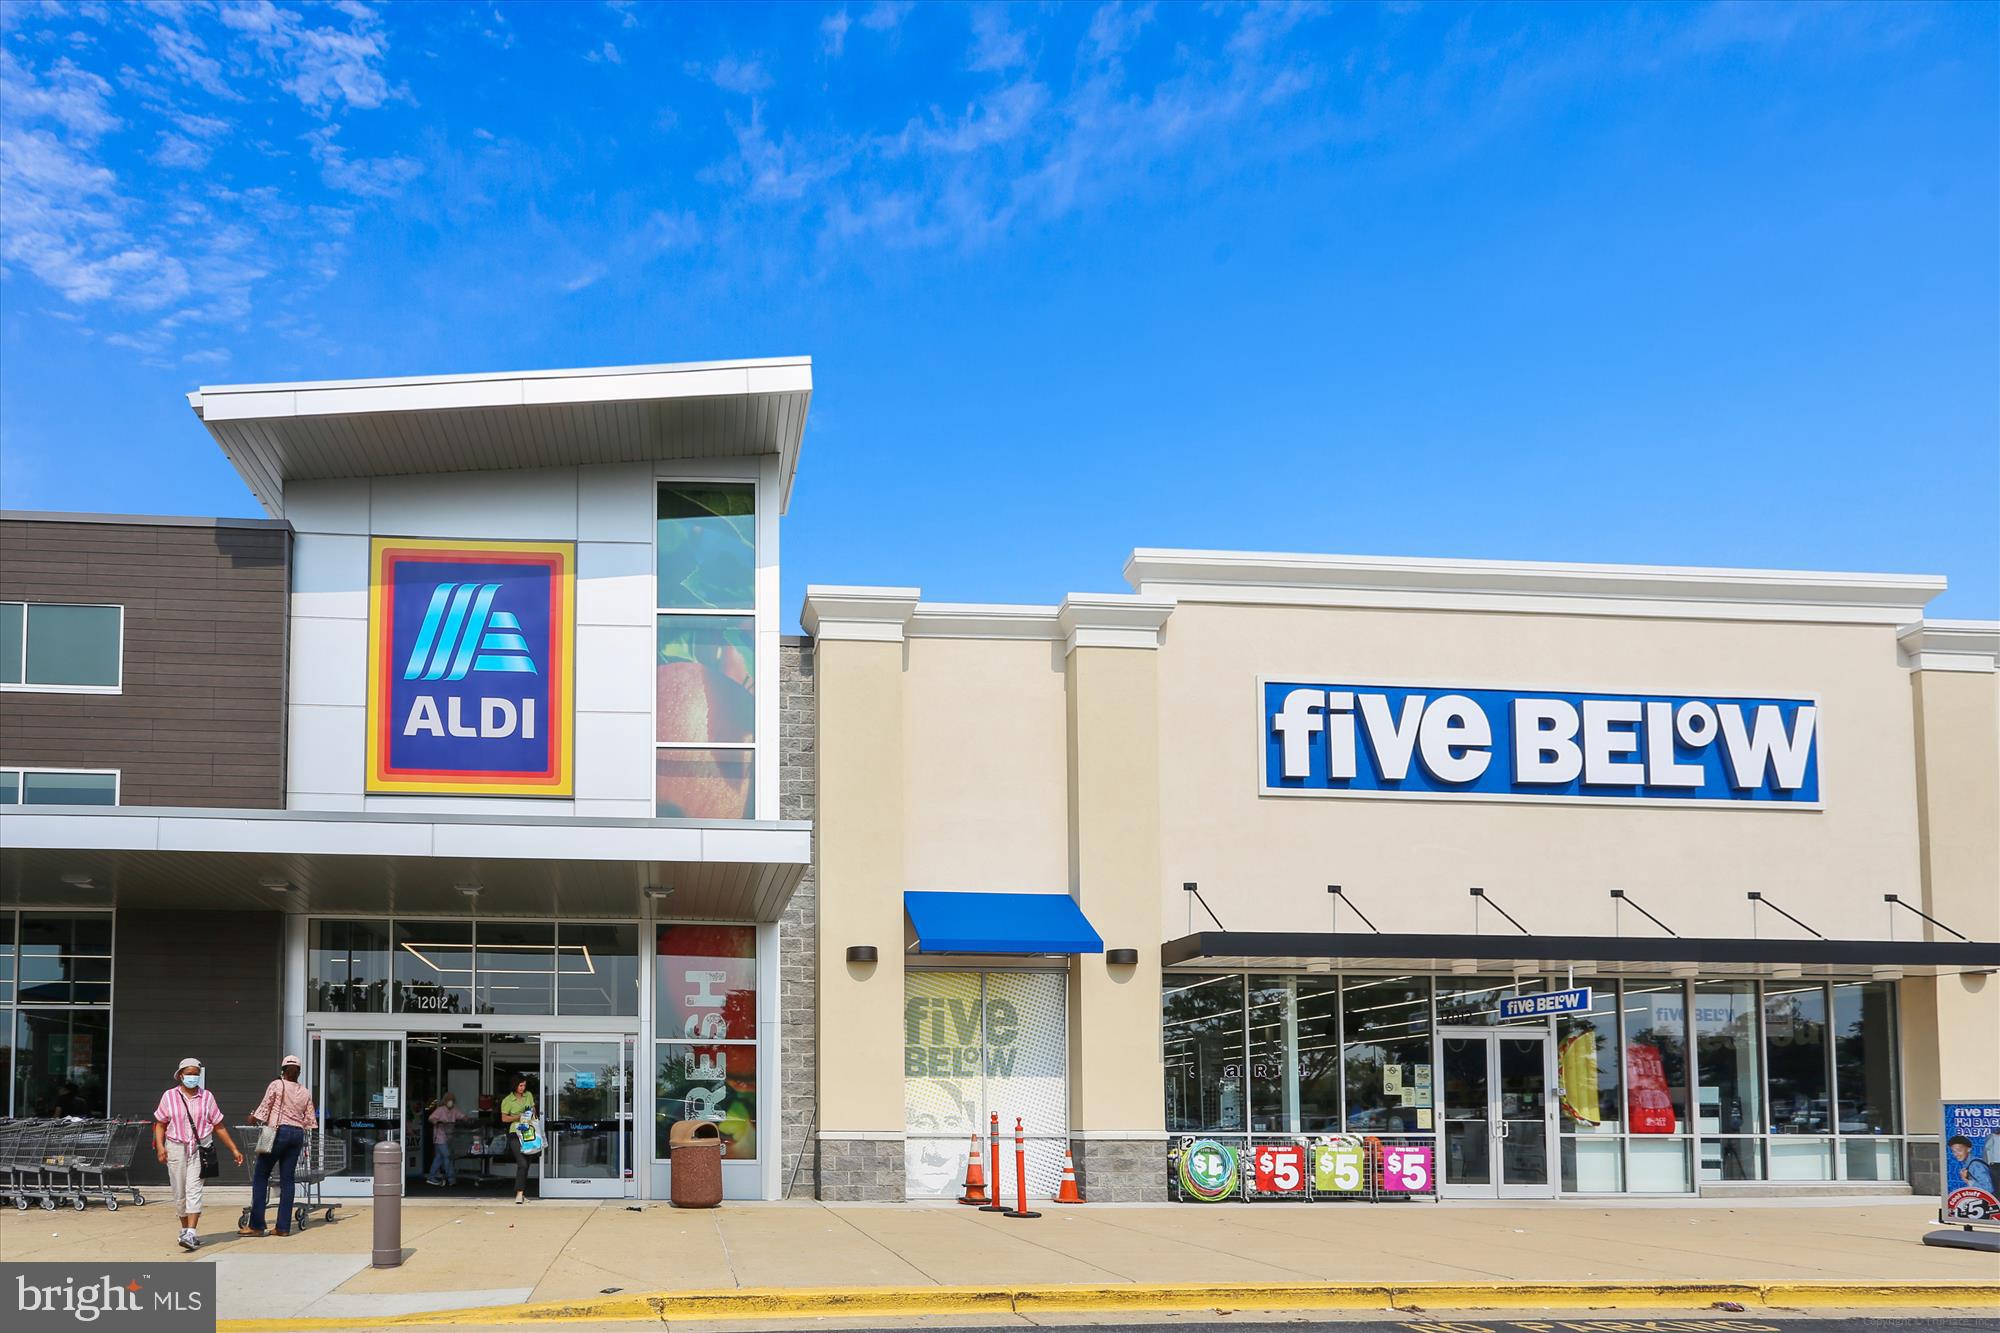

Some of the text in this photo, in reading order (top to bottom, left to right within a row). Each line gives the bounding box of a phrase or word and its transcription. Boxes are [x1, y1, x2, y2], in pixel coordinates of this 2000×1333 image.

[403, 695, 536, 739] ALDI
[1272, 689, 1817, 790] five BELOW
[417, 995, 448, 1010] 12012
[1507, 992, 1580, 1015] five BELOW
[906, 996, 1019, 1047] five
[685, 969, 727, 1155] RESH
[904, 1046, 1017, 1079] BELOW
[570, 1122, 594, 1130] Welcome
[1954, 1108, 2000, 1117] five BE
[1972, 1117, 2000, 1128] BAC
[1183, 1137, 1193, 1148] $2
[1259, 1152, 1300, 1190] $5
[1319, 1152, 1360, 1190] $5
[1387, 1152, 1427, 1190] $5
[1506, 1320, 1781, 1333] PARKING
